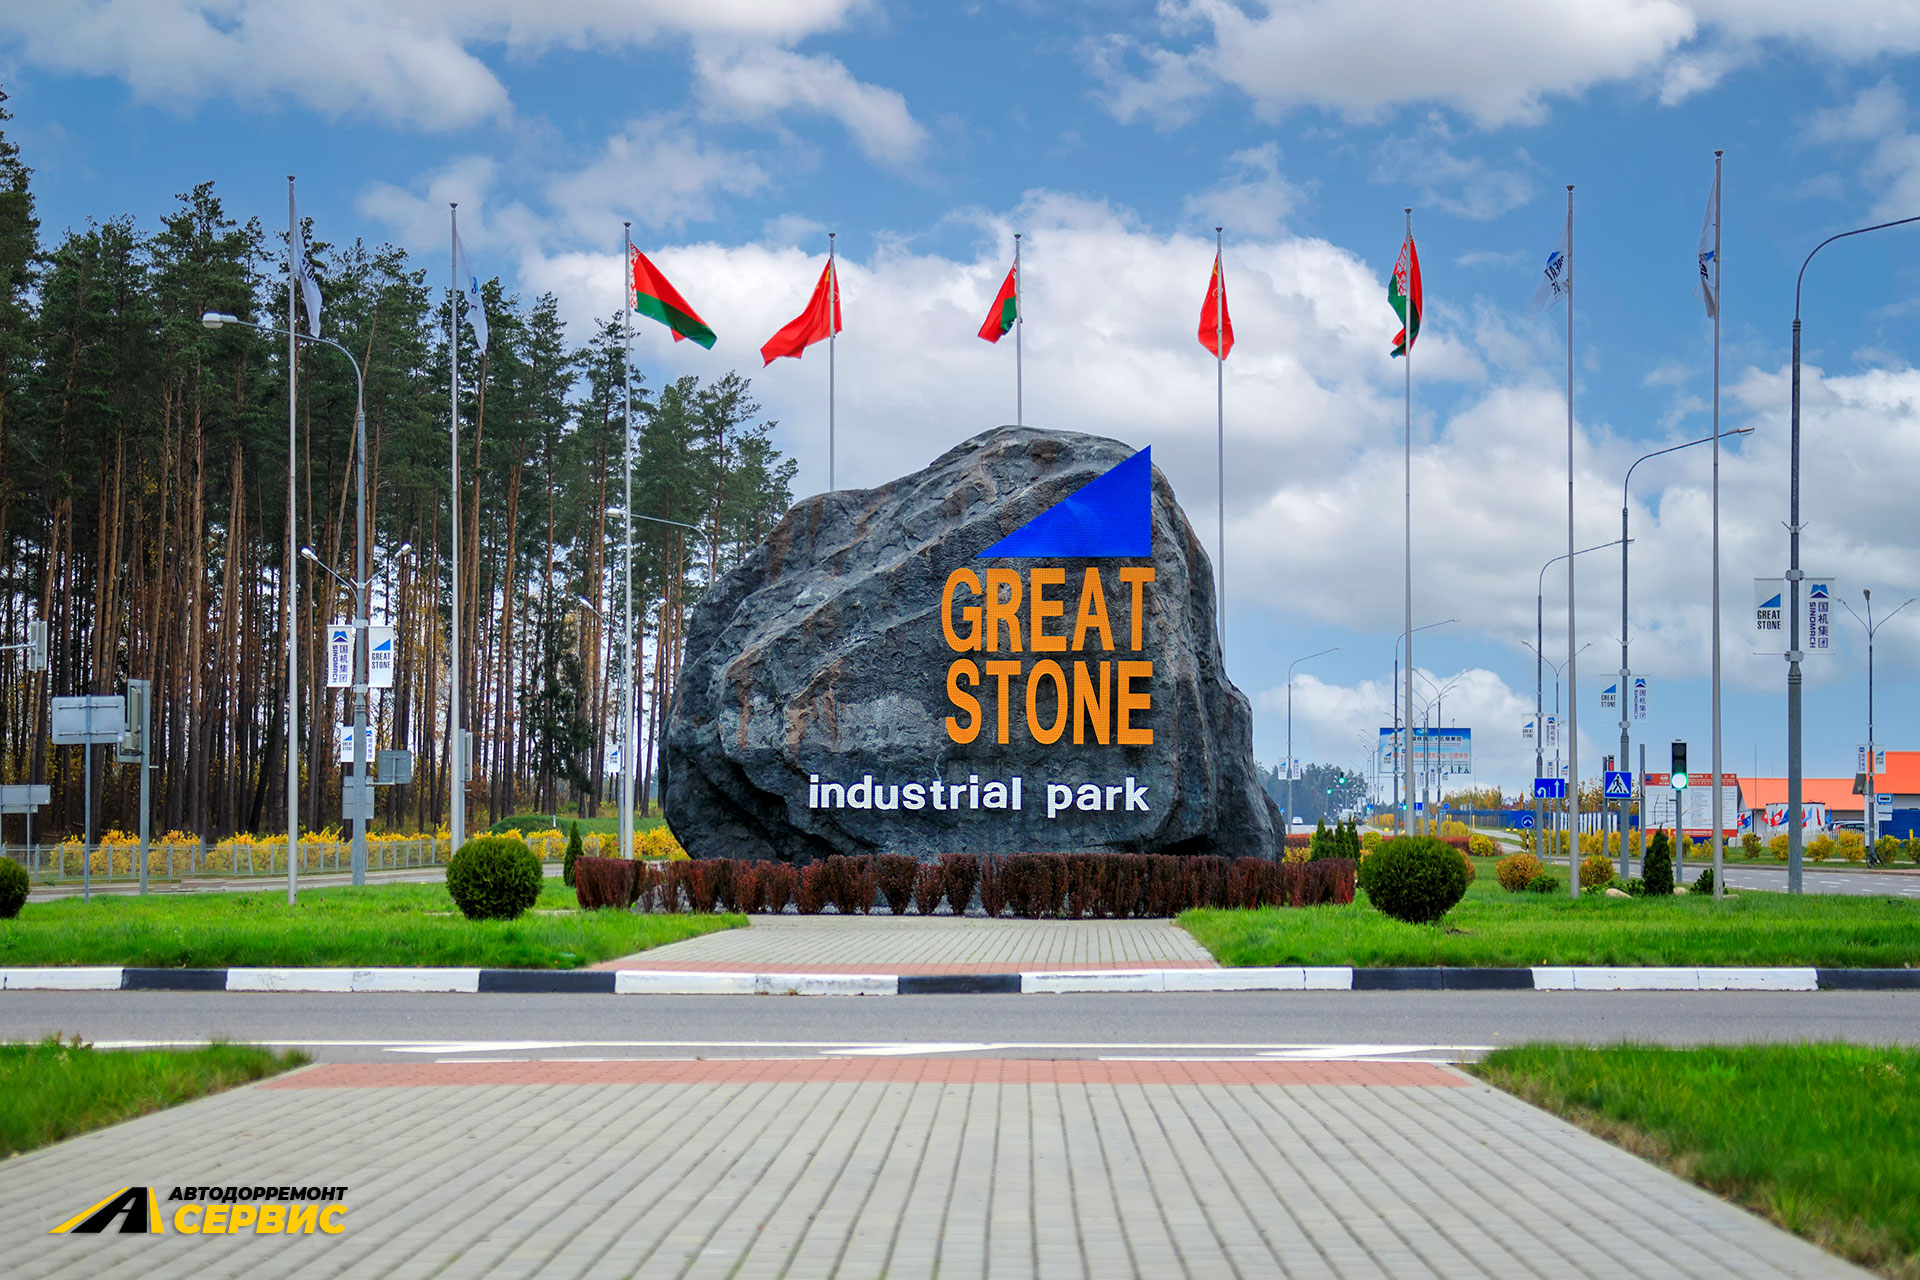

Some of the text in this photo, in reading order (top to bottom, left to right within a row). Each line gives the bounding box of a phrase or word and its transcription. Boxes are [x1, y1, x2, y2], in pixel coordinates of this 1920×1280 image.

[941, 567, 1156, 653] GREAT
[1757, 610, 1781, 620] GREAT
[1757, 620, 1781, 630] STONE
[1818, 601, 1829, 649] 国机集团
[371, 652, 391, 661] GREAT
[371, 661, 391, 669] STONE
[945, 659, 1154, 745] STONE
[808, 774, 1151, 819] industrial park
